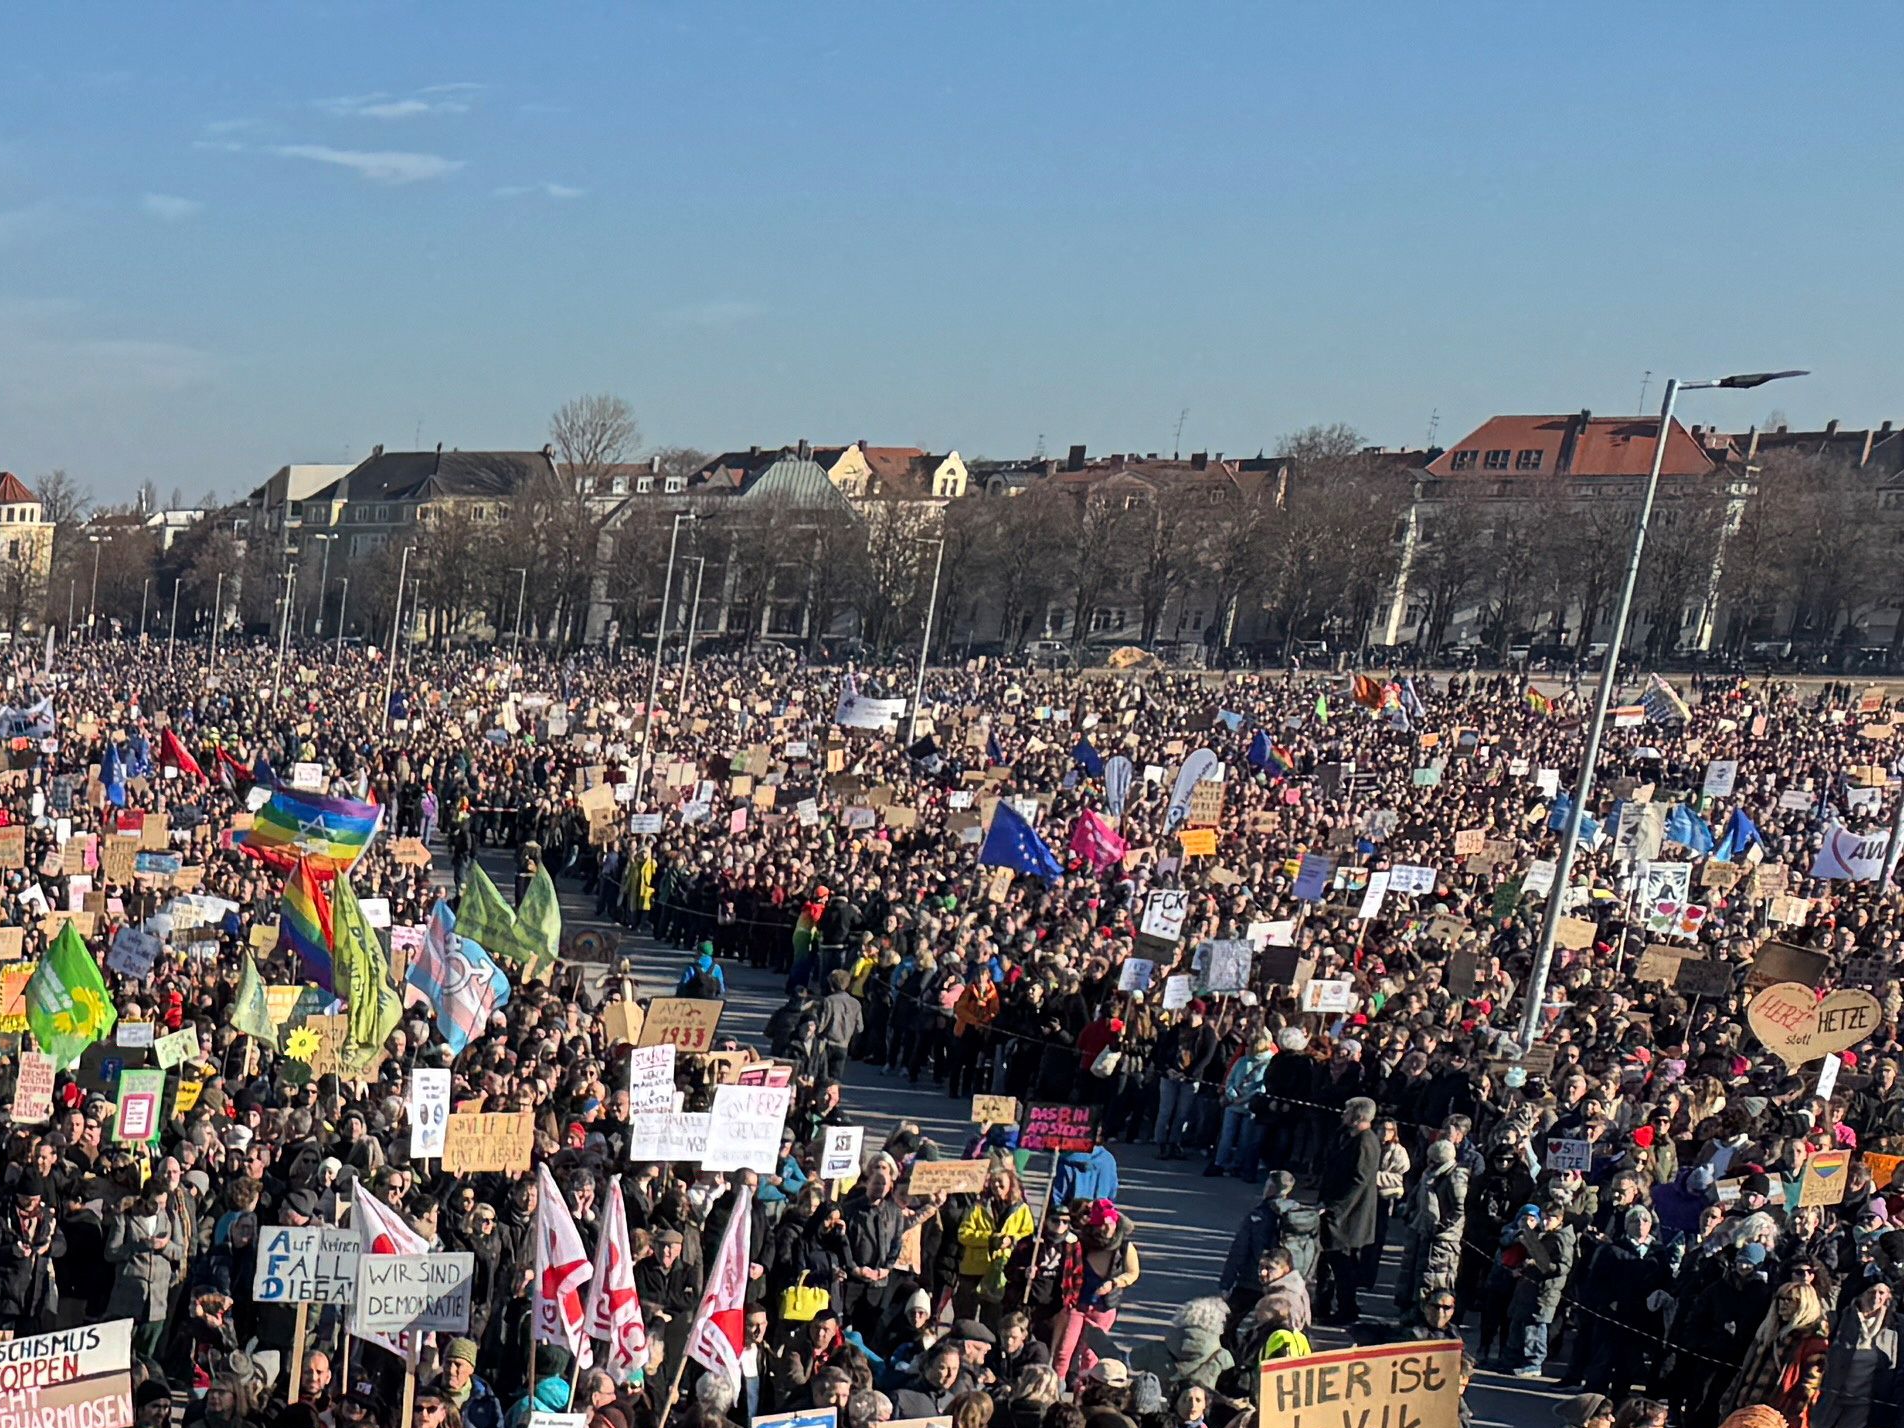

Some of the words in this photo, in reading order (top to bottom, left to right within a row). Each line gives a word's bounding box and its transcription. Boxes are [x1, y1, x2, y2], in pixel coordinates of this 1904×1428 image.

[1149, 892, 1189, 912] FCK
[1817, 1006, 1870, 1035] HETZE
[661, 1025, 707, 1049] 1933
[368, 1263, 414, 1286] WIR
[416, 1262, 461, 1284] SIND
[368, 1295, 465, 1318] DEMOKRATIE
[1275, 1360, 1374, 1413] HIER
